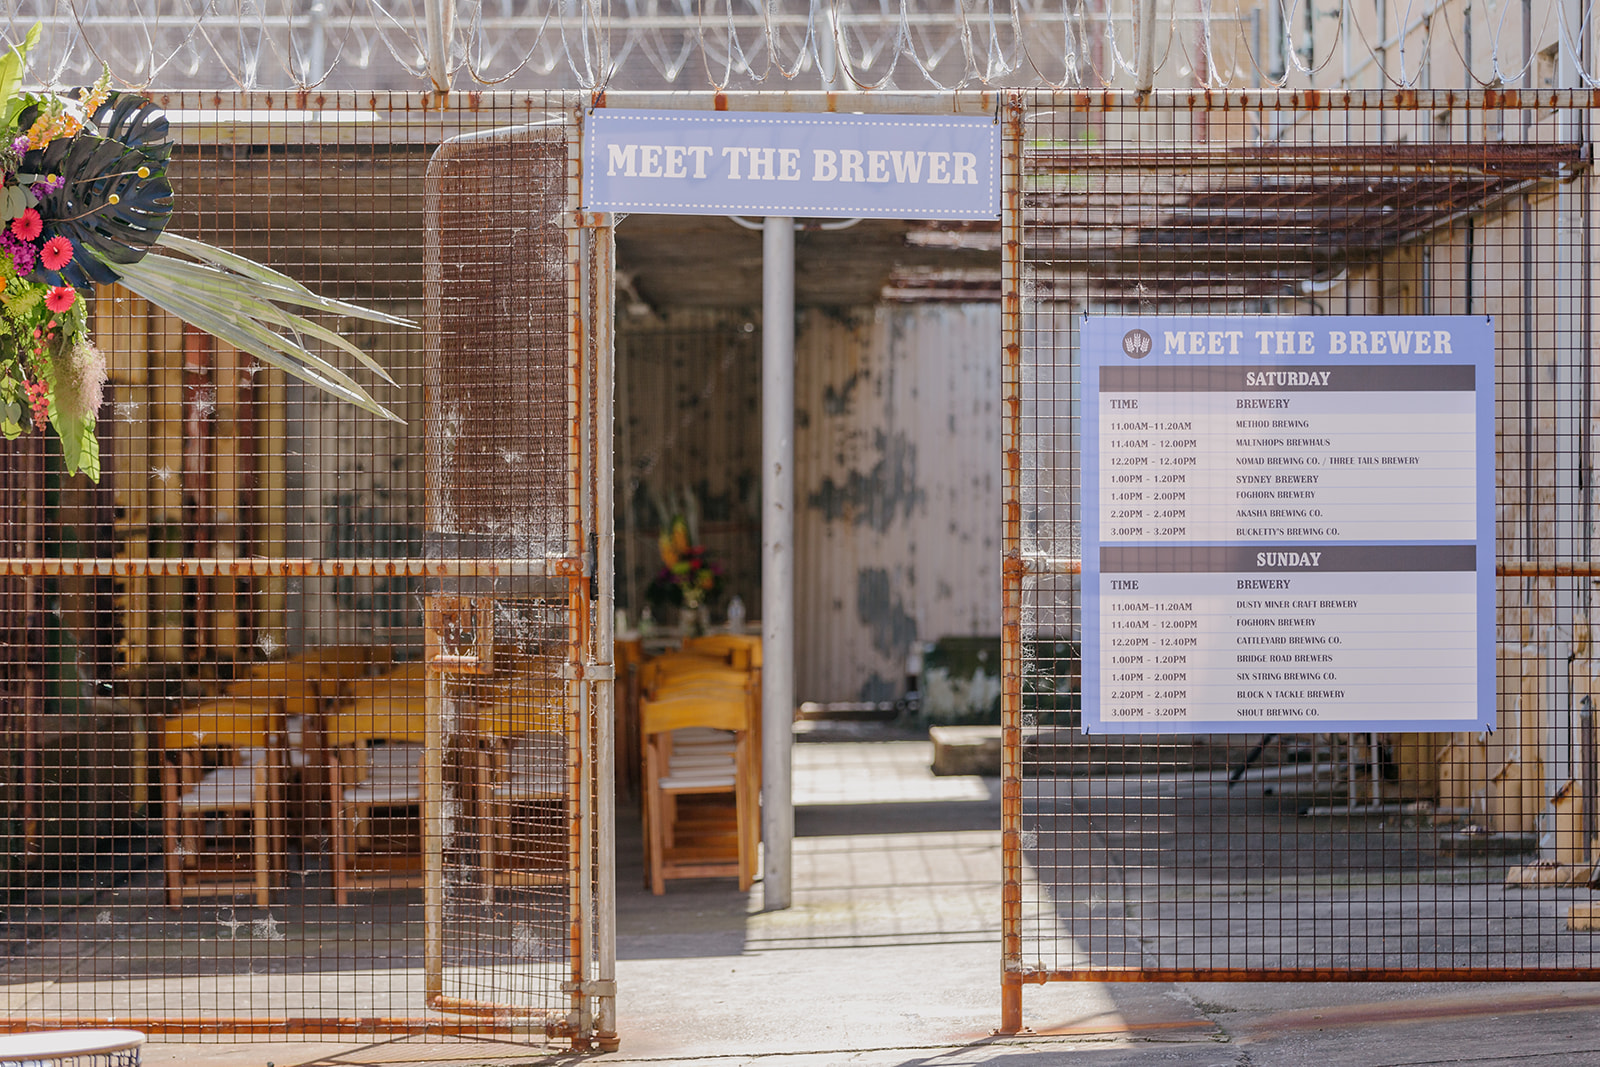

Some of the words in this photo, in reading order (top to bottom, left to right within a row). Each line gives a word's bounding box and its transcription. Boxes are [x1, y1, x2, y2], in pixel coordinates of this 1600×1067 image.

[606, 144, 714, 179] MEET
[722, 147, 801, 181] THE
[812, 149, 979, 184] BREWER
[1163, 331, 1243, 355] MEET
[1255, 331, 1315, 355] THE
[1328, 331, 1453, 355] BREWER
[1246, 371, 1331, 387] SATURDAY
[1110, 399, 1139, 409] TIME
[1236, 399, 1290, 409] BREWERY
[1236, 420, 1270, 428] METHOD
[1272, 420, 1309, 428] BREWING
[1111, 439, 1149, 448] 11.40AM
[1160, 439, 1197, 448] 12.00PM
[1286, 438, 1331, 447] BREWHAUS
[1111, 457, 1148, 466] 12.20PM
[1160, 457, 1197, 466] 12.40PM
[1236, 456, 1265, 465] NOMAD
[1267, 456, 1304, 465] BREWING
[1306, 456, 1320, 465] CO.
[1322, 456, 1327, 465] /
[1329, 456, 1356, 465] THREE
[1357, 456, 1379, 465] TAILS
[1381, 456, 1420, 465] BREWERY
[1111, 474, 1143, 483] 1.00PM
[1154, 474, 1186, 483] 1.20PM
[1236, 475, 1272, 484] SYDNEY
[1275, 475, 1319, 484] BREWERY
[1111, 492, 1143, 501] 1.40PM
[1154, 492, 1186, 501] 2.00PM
[1236, 491, 1275, 499] FOGHORN
[1277, 491, 1316, 499] BREWERY
[1111, 509, 1142, 518] 2.20PM
[1153, 509, 1186, 518] 2.40PM
[1236, 509, 1268, 517] AKASHA
[1270, 509, 1307, 517] BREWING
[1309, 509, 1323, 517] CO.
[1111, 526, 1142, 536] 3.00PM
[1153, 526, 1186, 536] 3.20PM
[1236, 528, 1284, 536] BUCKETTY'S
[1286, 528, 1324, 536] BREWING
[1326, 528, 1340, 536] CO.
[1256, 552, 1322, 568] SUNDAY
[1110, 580, 1139, 590] TIME
[1236, 580, 1290, 590] BREWERY
[1236, 600, 1263, 609] DUSTY
[1265, 600, 1290, 609] MINER
[1292, 600, 1317, 609] CRAFT
[1319, 600, 1358, 609] BREWERY
[1112, 620, 1149, 629] 11.40AM
[1161, 620, 1198, 629] 12.00PM
[1237, 618, 1275, 626] FOGHORN
[1278, 618, 1316, 626] BREWERY
[1112, 638, 1149, 647] 12.20PM
[1160, 638, 1197, 647] 12.40PM
[1237, 636, 1287, 645] CATTLEYARD
[1289, 636, 1326, 645] BREWING
[1328, 636, 1342, 645] CO.
[1112, 655, 1143, 664] 1.00PM
[1155, 655, 1187, 664] 1.20PM
[1237, 654, 1267, 662] BRIDGE
[1270, 654, 1292, 662] ROAD
[1294, 654, 1333, 662] BREWERS
[1112, 673, 1144, 682] 1.40PM
[1154, 673, 1187, 682] 2.00PM
[1237, 672, 1250, 681] SIX
[1252, 672, 1282, 681] STRING
[1284, 672, 1321, 681] BREWING
[1323, 672, 1337, 681] CO.
[1111, 690, 1144, 699] 2.20PM
[1154, 690, 1187, 699] 2.40PM
[1237, 690, 1264, 699] BLOCK
[1266, 690, 1272, 699] N
[1274, 690, 1305, 699] TACKLE
[1307, 690, 1345, 699] BREWERY
[1111, 708, 1144, 717] 3.00PM
[1154, 708, 1187, 717] 3.20PM
[1237, 708, 1264, 717] SHOUT
[1266, 708, 1304, 717] BREWING
[1305, 708, 1319, 717] CO.
